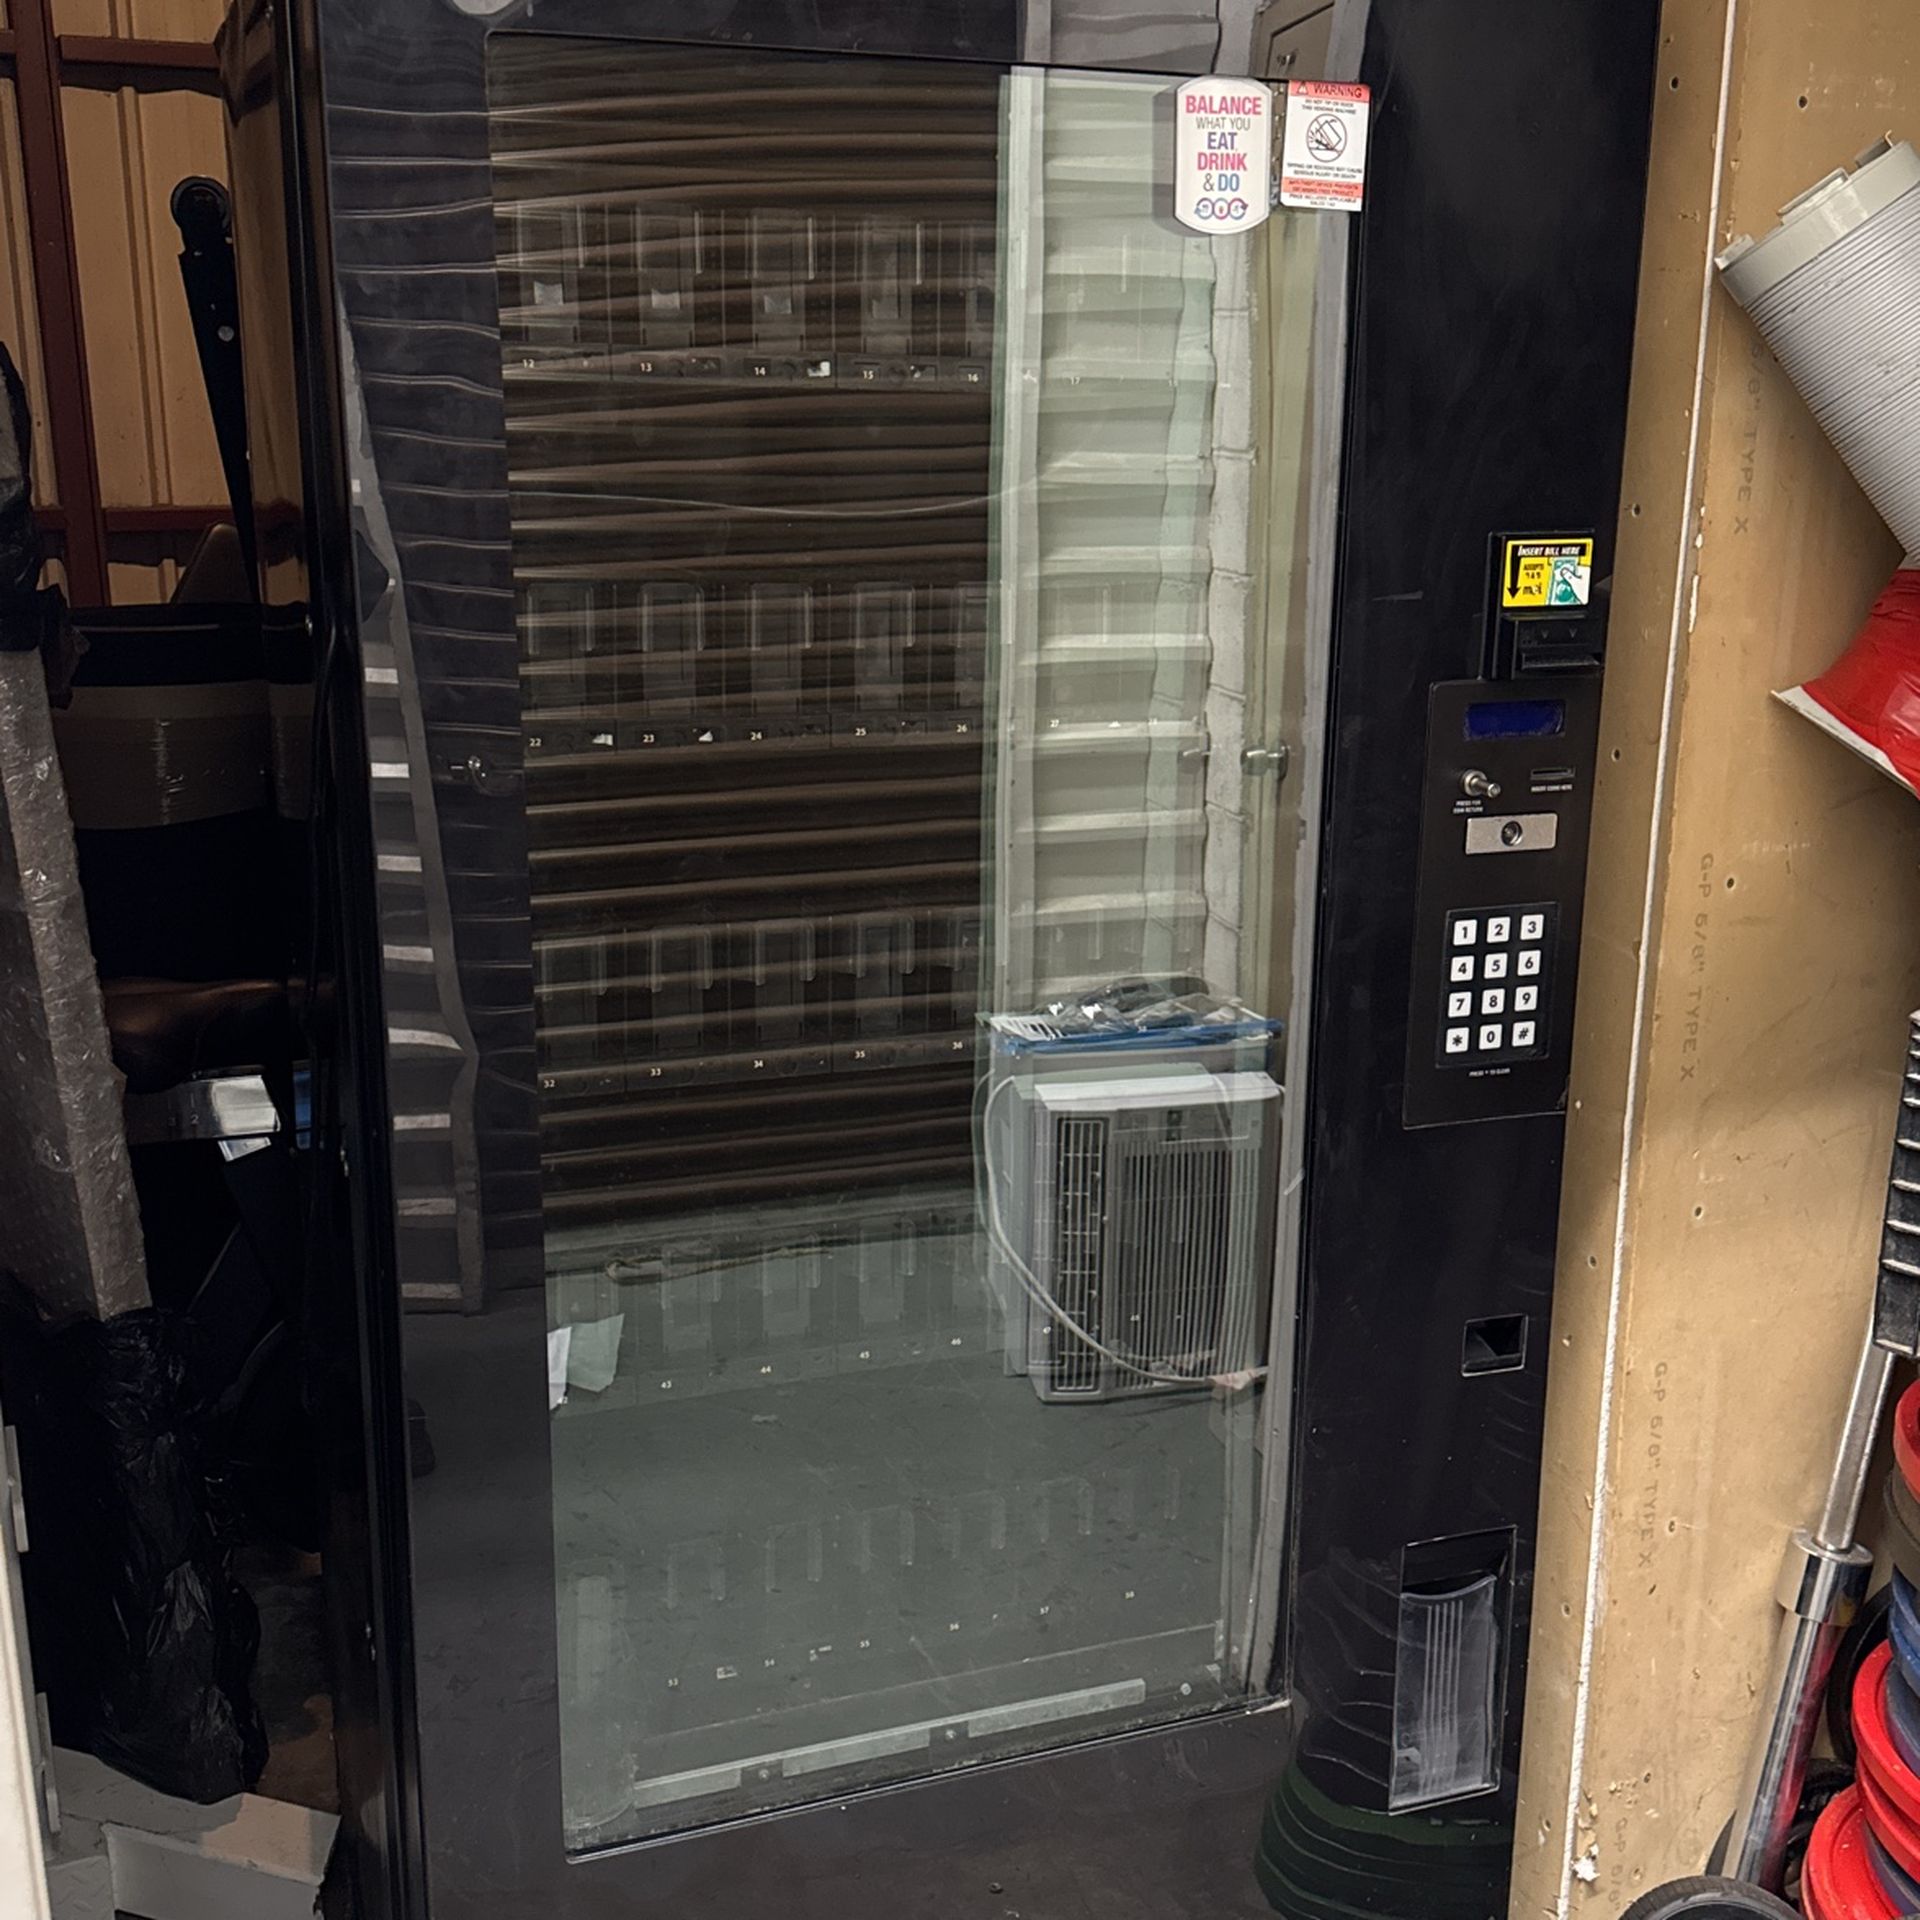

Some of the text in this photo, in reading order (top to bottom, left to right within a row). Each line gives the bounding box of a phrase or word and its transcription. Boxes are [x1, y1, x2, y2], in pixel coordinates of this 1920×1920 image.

[1314, 84, 1363, 98] WARNING
[1185, 95, 1263, 116] BALANCE
[1196, 116, 1251, 131] WHAT YOU
[1197, 152, 1248, 171] DRINK
[1203, 173, 1240, 192] & DO
[522, 359, 535, 368] 12
[639, 362, 653, 372] 13
[754, 366, 766, 376] 14
[863, 370, 874, 380] 15
[967, 373, 979, 382] 16
[1737, 429, 1758, 503] TYPE
[1734, 516, 1749, 535] X
[1517, 545, 1581, 556] INSERT BILL HERE
[956, 724, 968, 733] 26
[529, 738, 541, 747] 22
[642, 734, 655, 743] 23
[751, 731, 763, 741] 24
[1698, 852, 1714, 898] G-P
[1462, 921, 1537, 939] 1 2 3
[1458, 957, 1534, 974] 4 5 6
[1456, 992, 1531, 1010] 7 8 9
[1682, 985, 1702, 1054] TYPE
[1486, 1031, 1495, 1043] 0
[1519, 1027, 1529, 1039] #
[855, 1050, 866, 1059] 35
[753, 1059, 764, 1069] 34
[650, 1068, 662, 1077] 33
[1680, 1064, 1695, 1082] X
[543, 1079, 556, 1088] 32
[760, 1366, 772, 1374] 44
[661, 1380, 672, 1389] 43
[1653, 1361, 1668, 1402] G-P
[1640, 1480, 1659, 1541] TYPE
[1638, 1552, 1653, 1568] X
